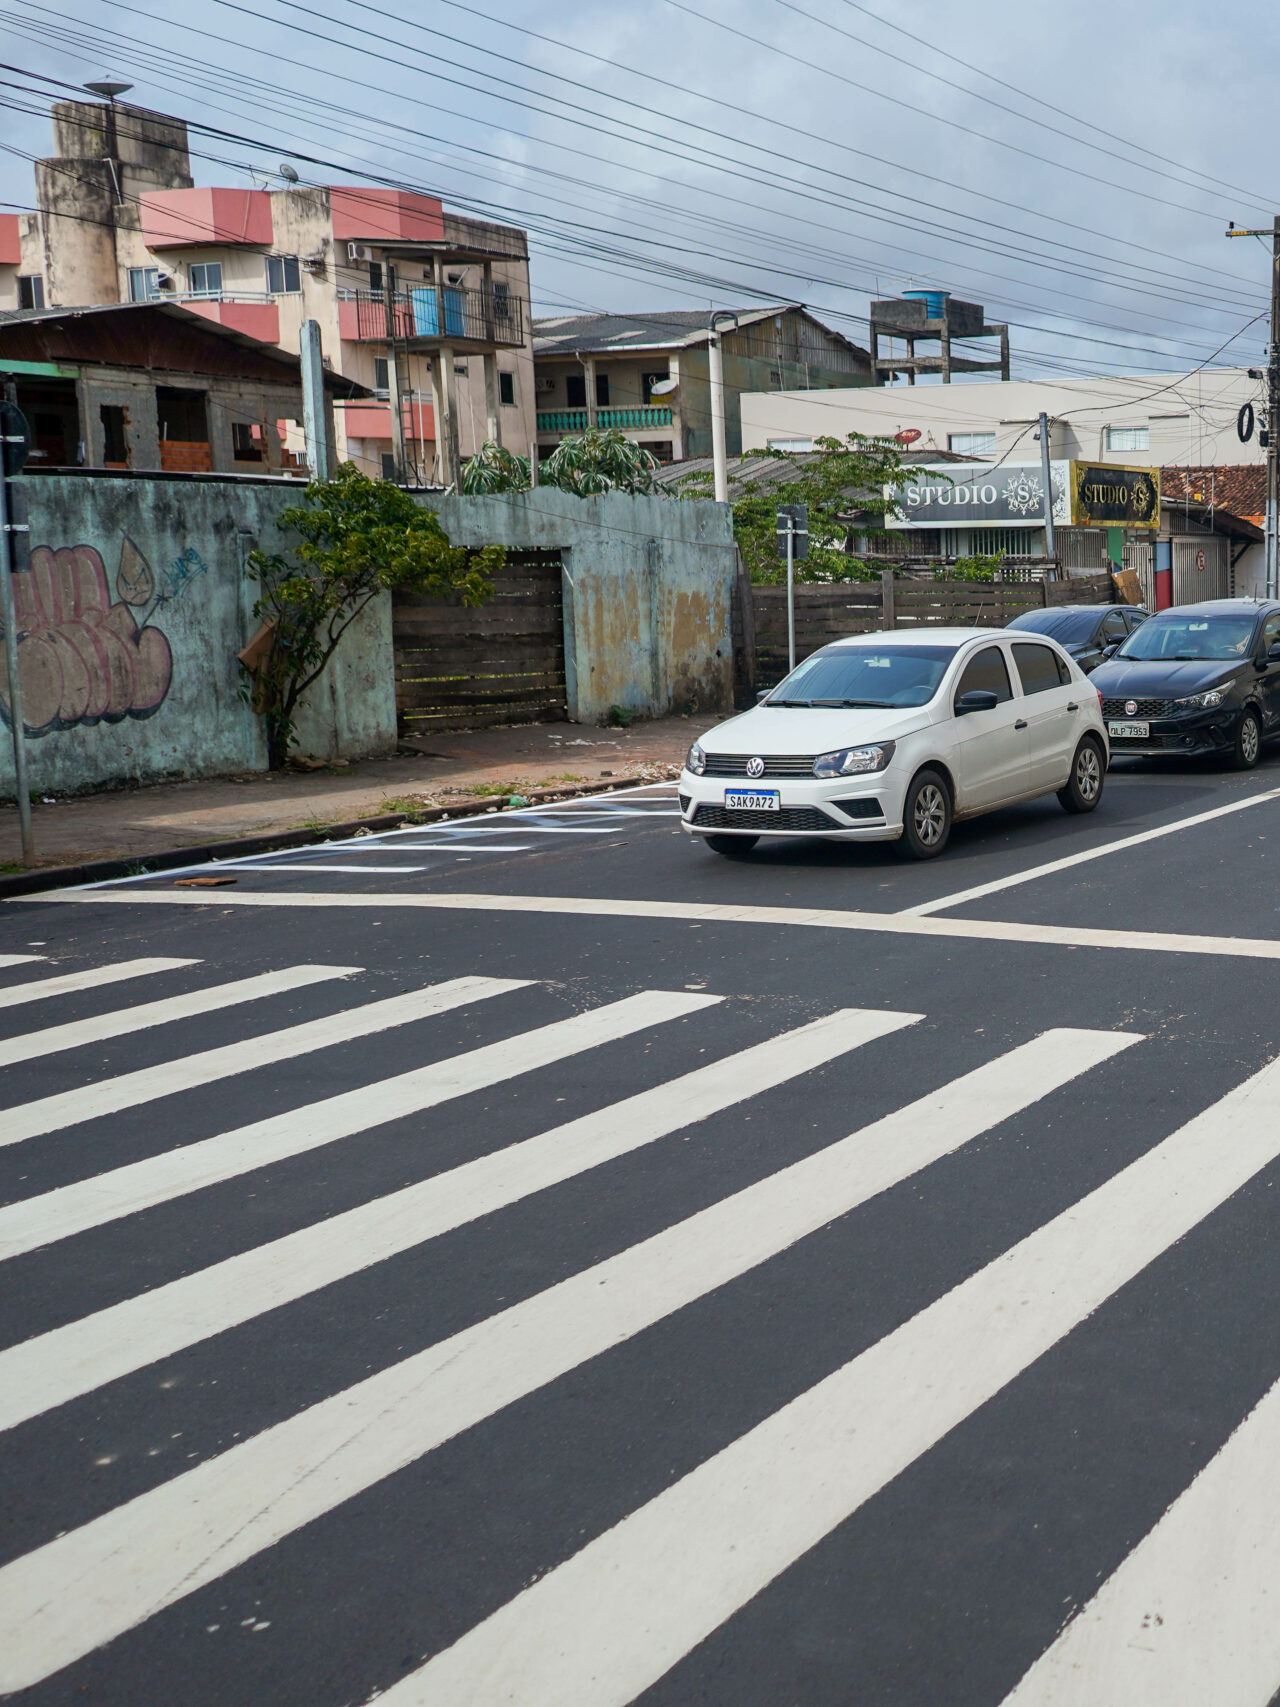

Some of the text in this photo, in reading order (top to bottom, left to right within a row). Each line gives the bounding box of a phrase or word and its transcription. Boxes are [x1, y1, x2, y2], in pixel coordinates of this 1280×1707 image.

[906, 484, 998, 506] STUDIO
[1084, 484, 1128, 505] STUDIO
[1128, 727, 1148, 737] 7953
[730, 795, 774, 809] SAK9A72
